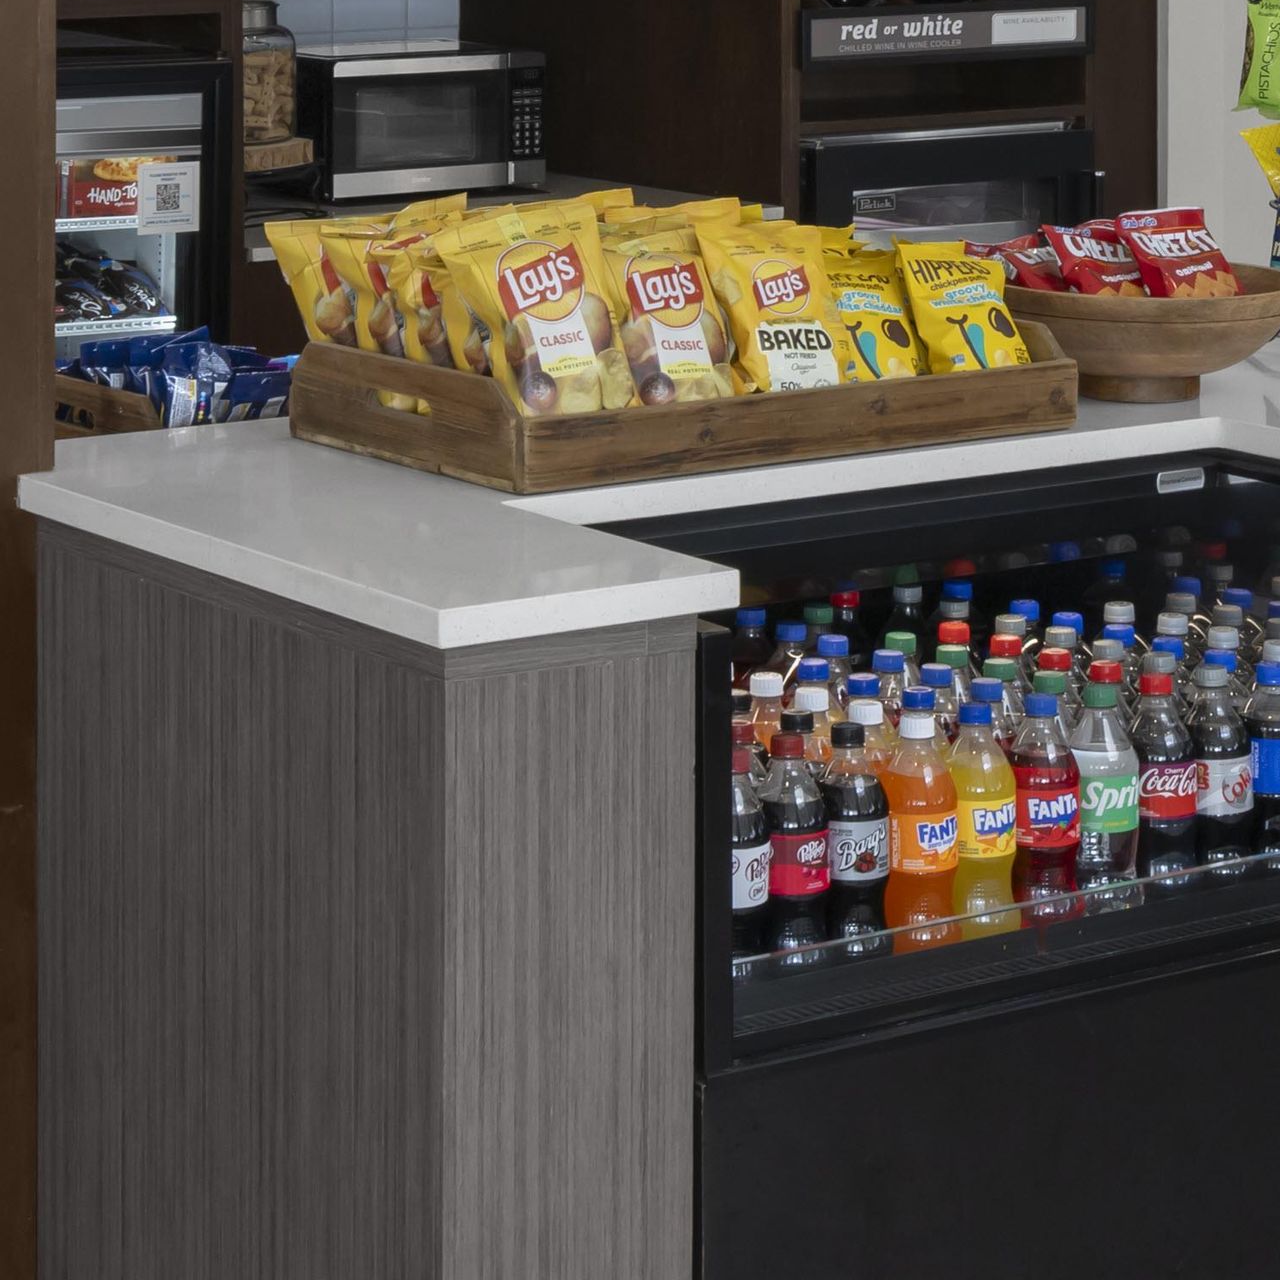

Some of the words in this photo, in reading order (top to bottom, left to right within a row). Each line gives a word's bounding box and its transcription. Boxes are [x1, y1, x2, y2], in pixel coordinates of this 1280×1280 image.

[841, 18, 878, 40] red
[883, 25, 898, 36] or
[903, 15, 964, 37] white
[1021, 15, 1066, 24] AVAILABILITY
[839, 42, 873, 53] CHILLED
[874, 42, 895, 51] WINE
[896, 41, 905, 49] IN
[907, 40, 928, 49] WINE
[930, 38, 962, 49] COOLER
[86, 182, 138, 203] HAND-TO
[503, 251, 579, 309] Lay's
[907, 260, 992, 286] HIPPEAS
[636, 263, 698, 310] Lay's
[755, 267, 808, 307] Lay's
[945, 283, 986, 300] groovy
[539, 329, 585, 348] CLASSIC
[661, 338, 704, 351] CLASSIC
[759, 327, 832, 351] BAKED
[1081, 776, 1139, 816] Spri
[973, 801, 1016, 831] FANT
[917, 816, 958, 844] FANT
[836, 823, 887, 871] Barq's
